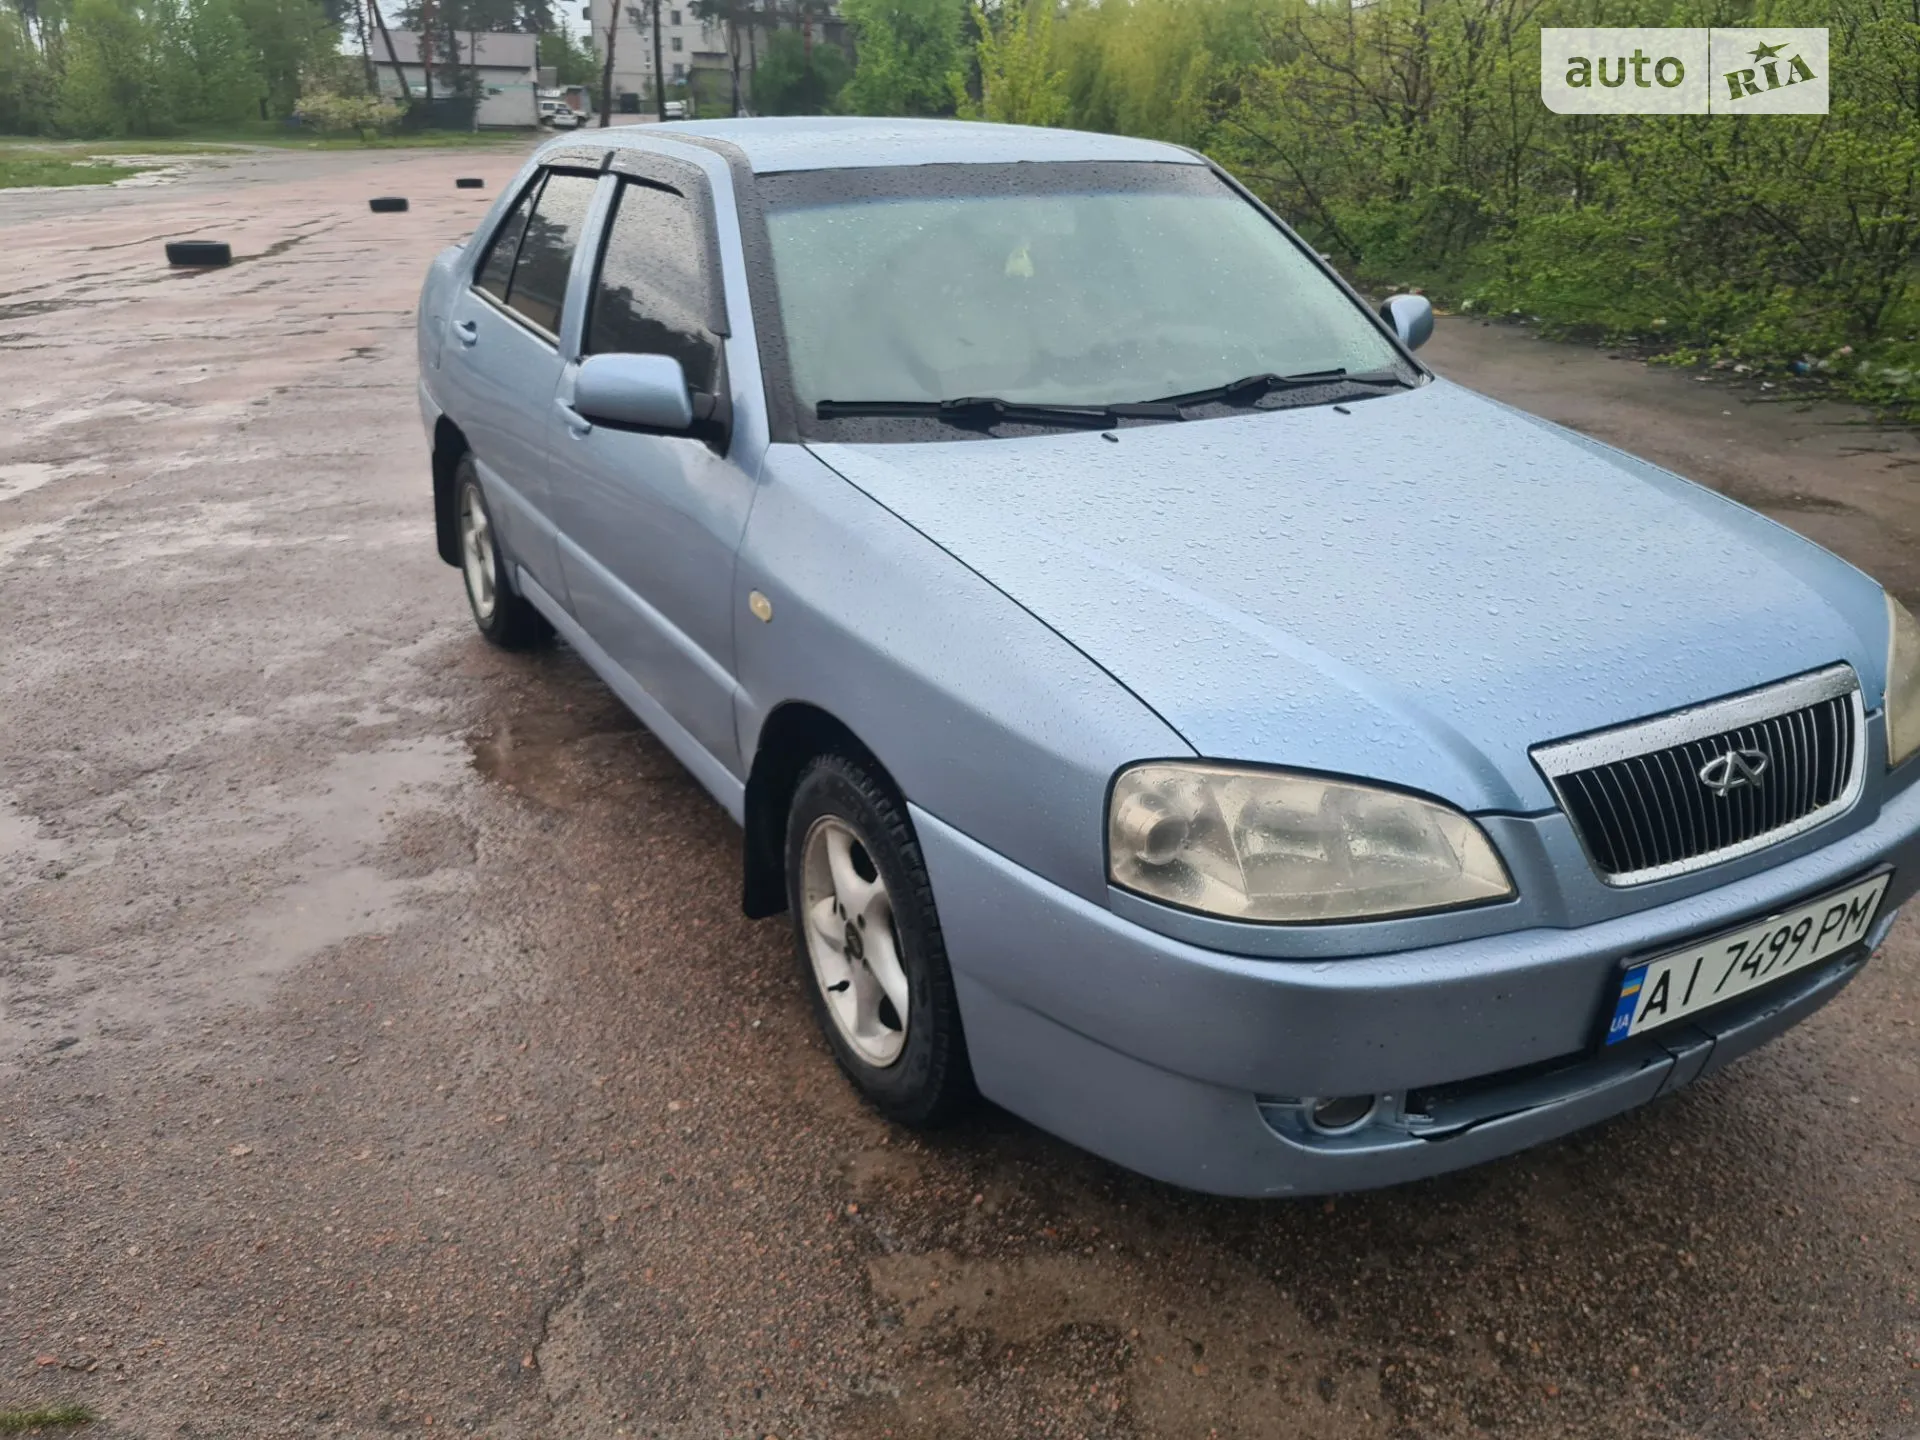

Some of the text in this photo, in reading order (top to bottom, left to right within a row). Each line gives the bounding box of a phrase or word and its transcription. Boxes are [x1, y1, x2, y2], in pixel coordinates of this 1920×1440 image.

[1636, 888, 1878, 1024] AI 7499 PM
[1610, 1014, 1630, 1033] UA
